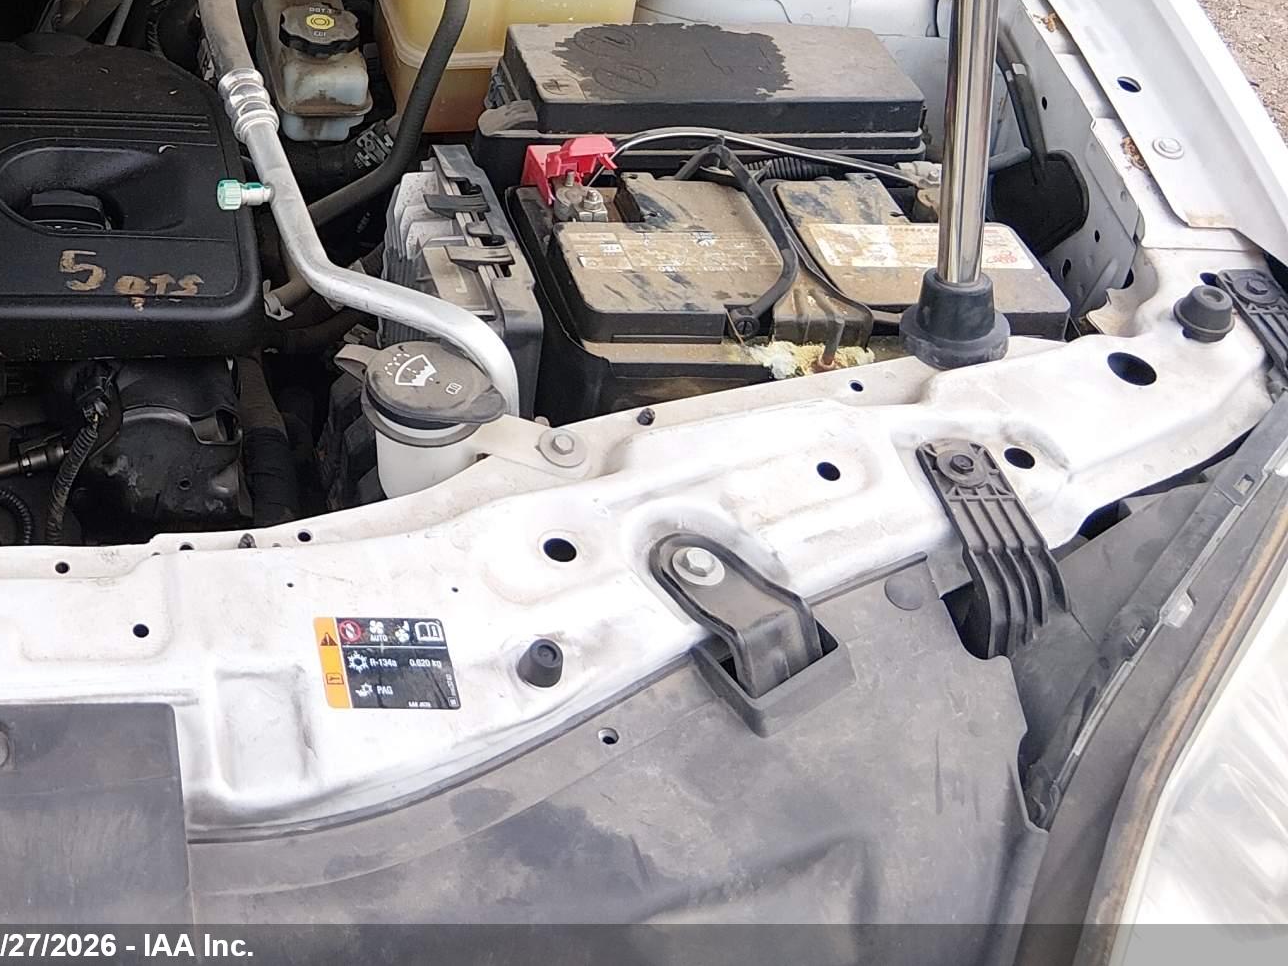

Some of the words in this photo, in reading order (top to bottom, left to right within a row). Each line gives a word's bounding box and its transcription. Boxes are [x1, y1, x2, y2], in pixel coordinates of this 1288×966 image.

[59, 249, 106, 291] 5
[370, 634, 388, 642] AUTO
[370, 659, 397, 667] R-134a
[431, 659, 442, 669] kg
